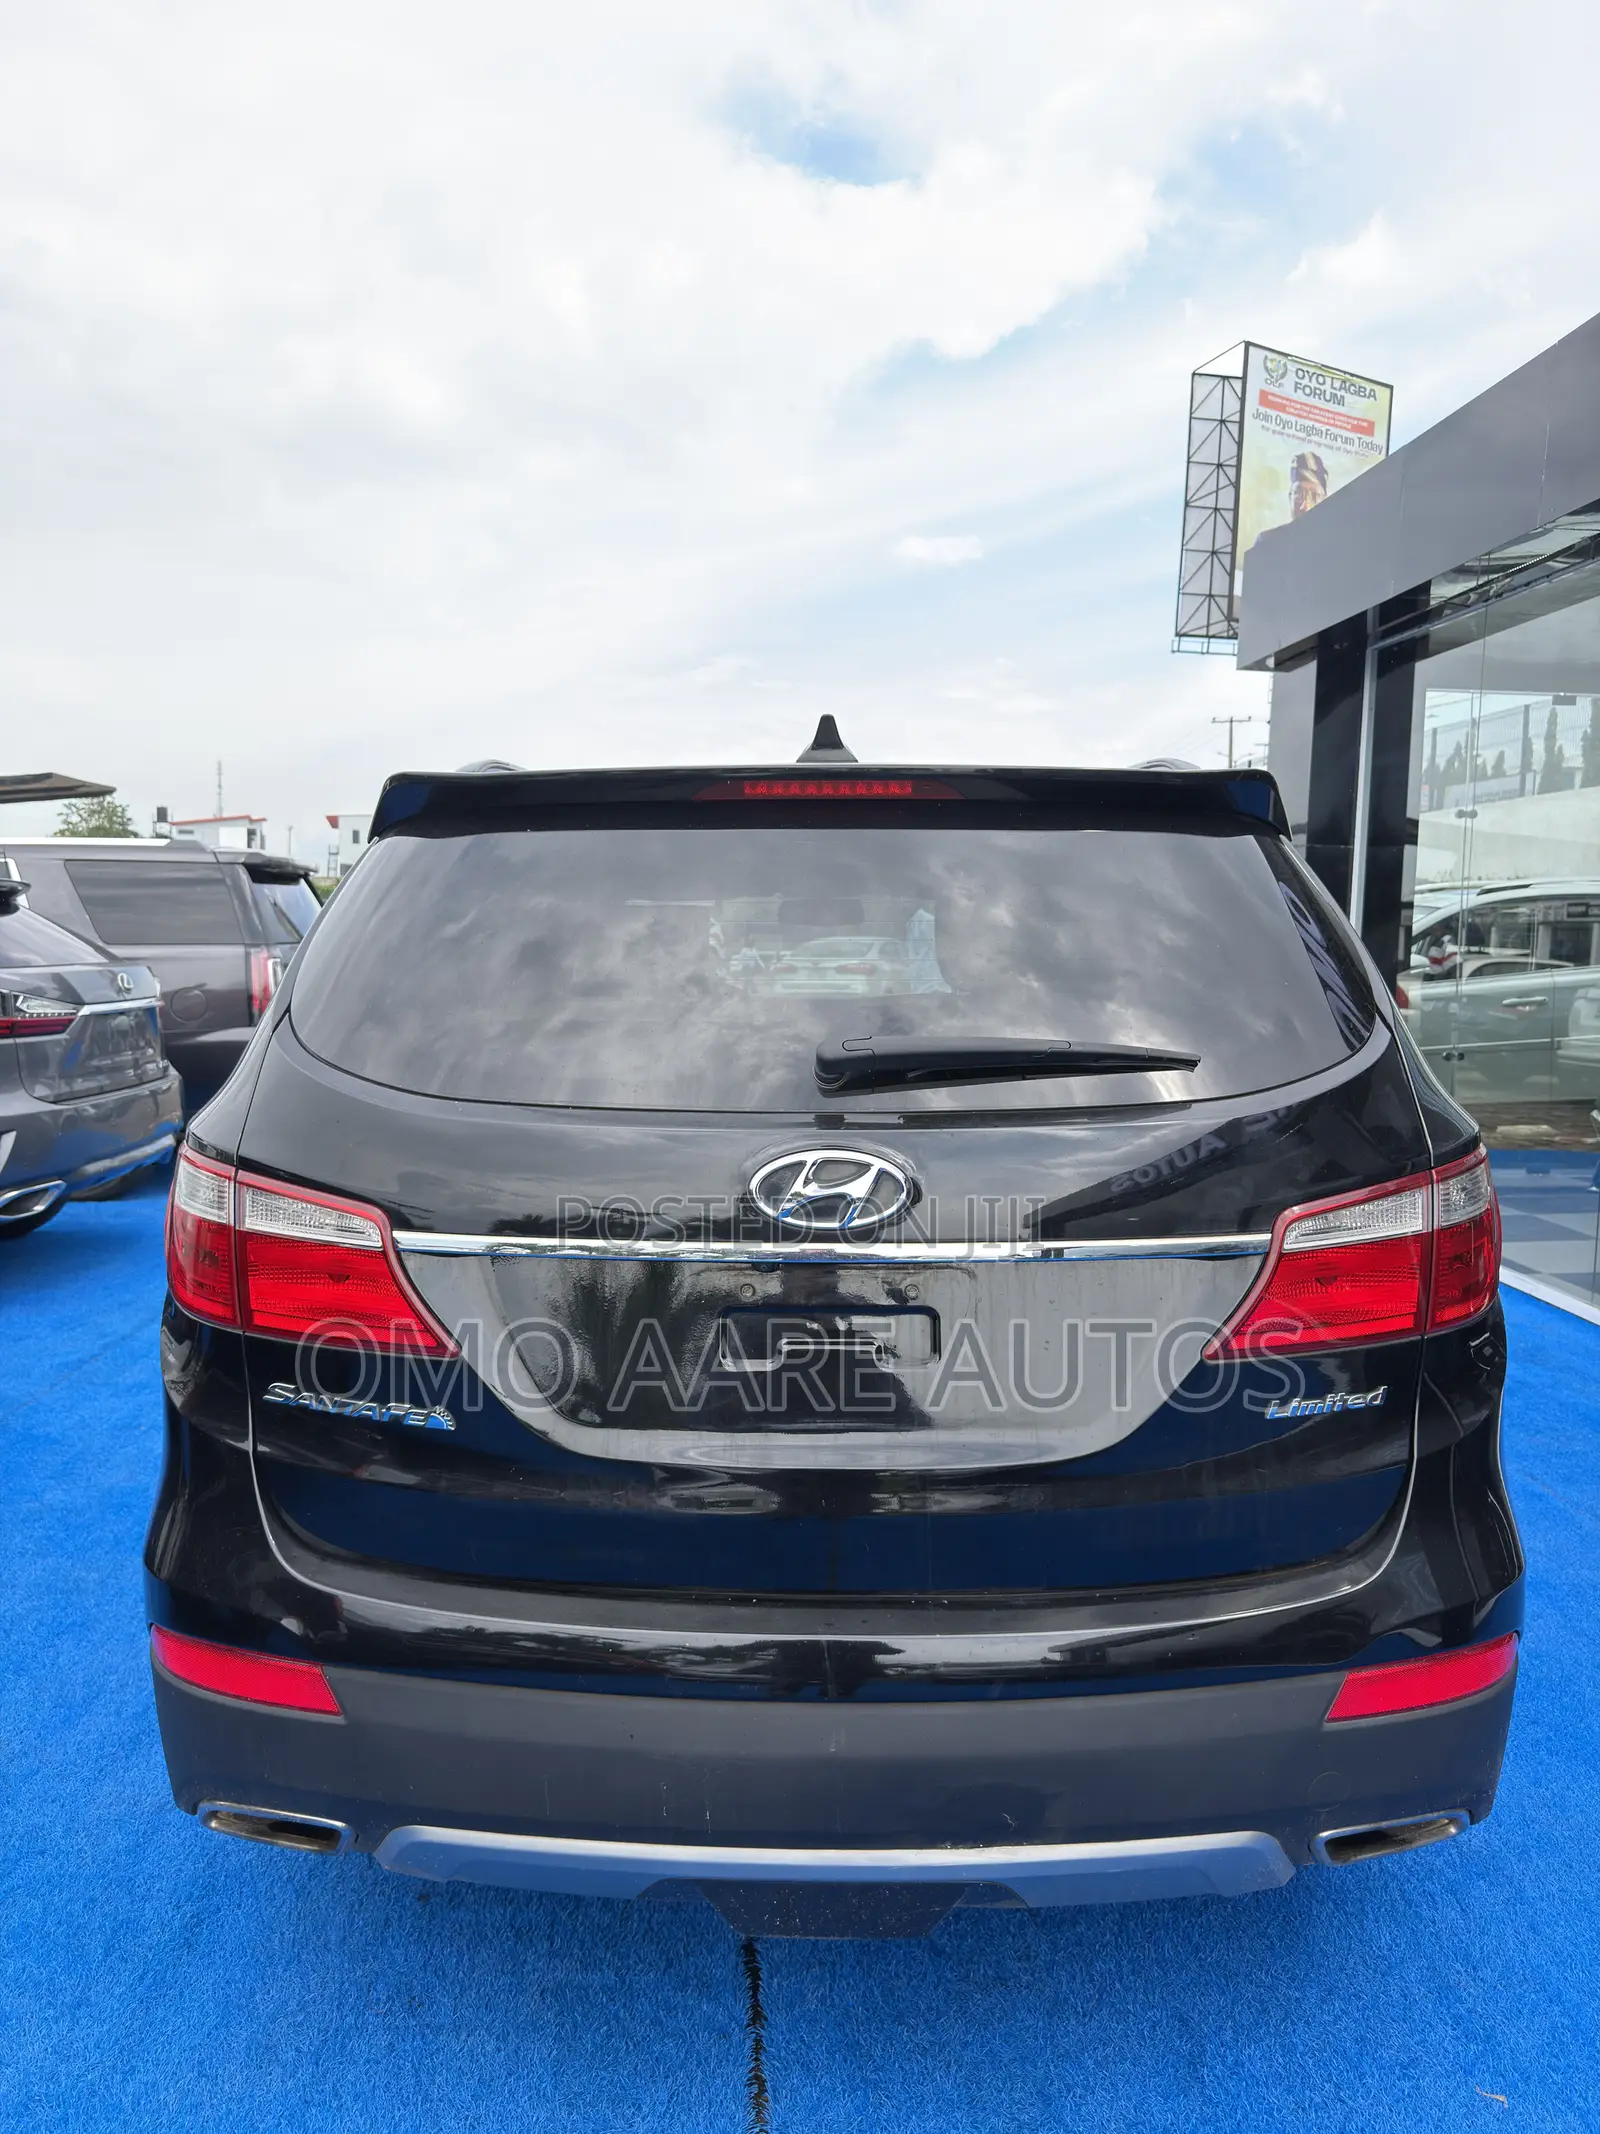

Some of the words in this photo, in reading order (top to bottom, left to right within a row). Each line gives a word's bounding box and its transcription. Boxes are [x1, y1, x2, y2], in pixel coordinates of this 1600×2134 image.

[1294, 380, 1346, 408] FORUM
[1295, 367, 1326, 386] OYO
[1330, 376, 1378, 402] LAGBA
[1252, 408, 1274, 424] Join
[1274, 414, 1293, 430] Oyo
[1294, 420, 1324, 438] Lagba
[1324, 428, 1355, 448] Forum
[1357, 435, 1384, 455] Today
[1265, 1385, 1388, 1419] Limited
